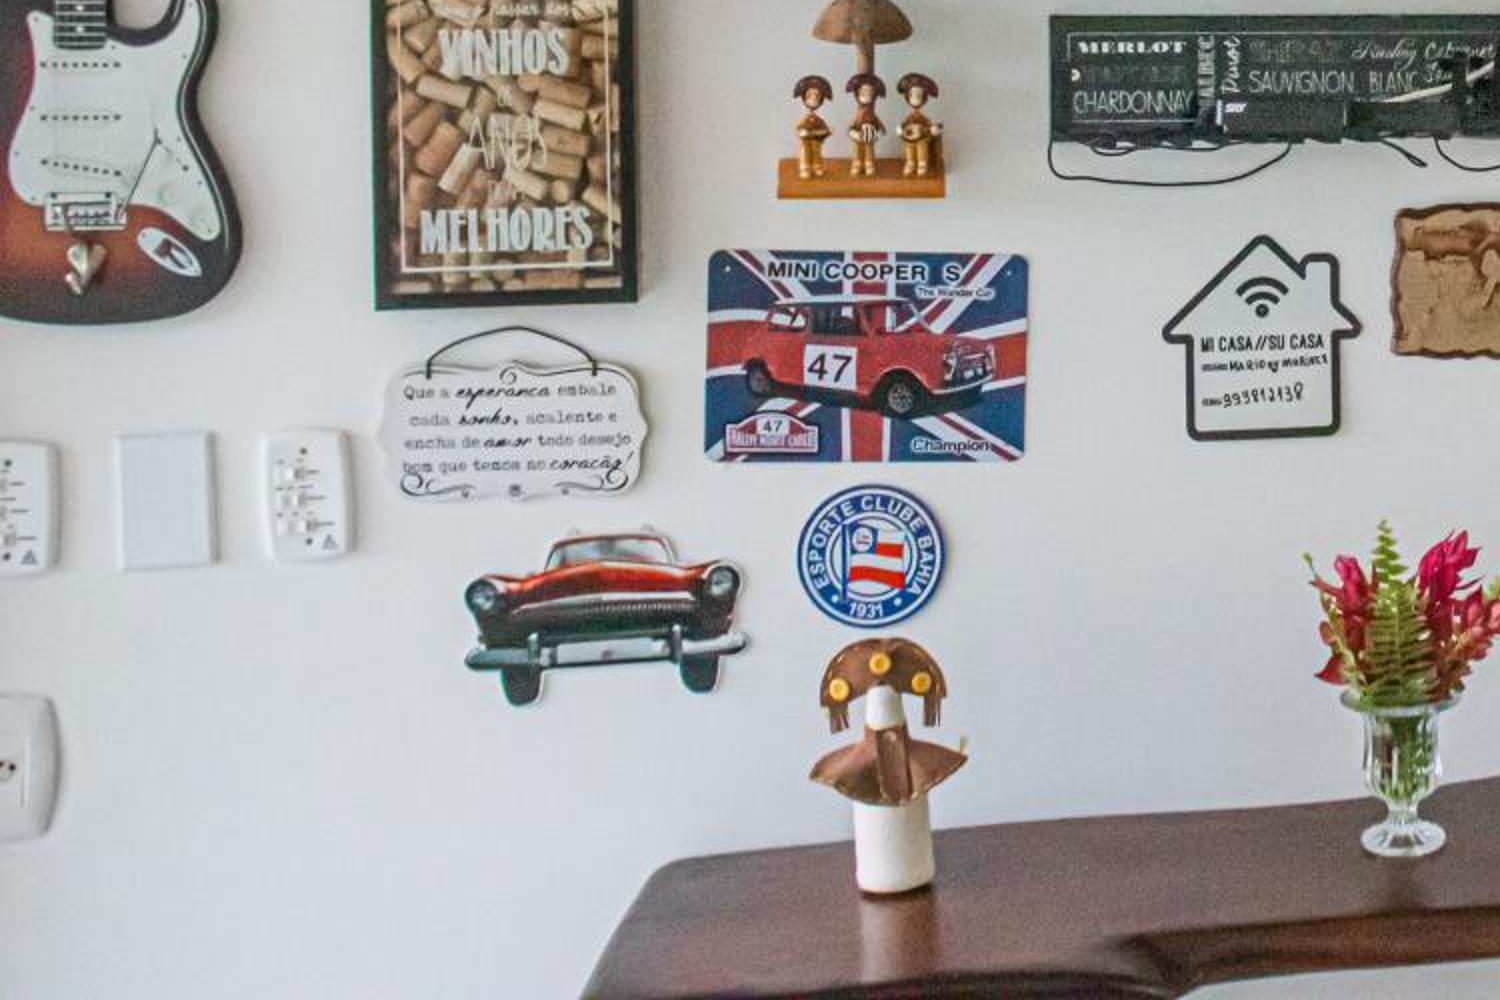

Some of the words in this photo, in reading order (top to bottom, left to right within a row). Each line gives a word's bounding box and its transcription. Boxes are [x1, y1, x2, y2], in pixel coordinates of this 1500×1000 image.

[437, 28, 569, 78] VINHOS
[1078, 41, 1187, 54] MERLOT
[1249, 70, 1354, 94] SAUVIGNON
[1369, 70, 1418, 93] BLANC
[1073, 89, 1193, 114] CHARDONNAY
[420, 206, 592, 254] MELHORES
[768, 262, 817, 279] MINI
[824, 262, 927, 281] COOPER
[945, 263, 961, 281] S
[1201, 337, 1214, 353] MI
[1289, 333, 1325, 350] CASA
[807, 354, 853, 383] 47
[403, 386, 435, 400] Que
[557, 383, 617, 398] embale
[410, 413, 450, 426] cada
[526, 410, 604, 425] acalente
[608, 413, 617, 424] e
[763, 419, 783, 433] 47
[462, 435, 480, 449] de
[538, 434, 573, 447] todo
[579, 433, 632, 449] desejo
[438, 461, 467, 474] que
[527, 459, 545, 471] no
[809, 501, 855, 589] ESPORTE
[861, 495, 923, 532] CLUBE
[909, 535, 935, 595] BAHIA
[849, 602, 884, 618] 1931
